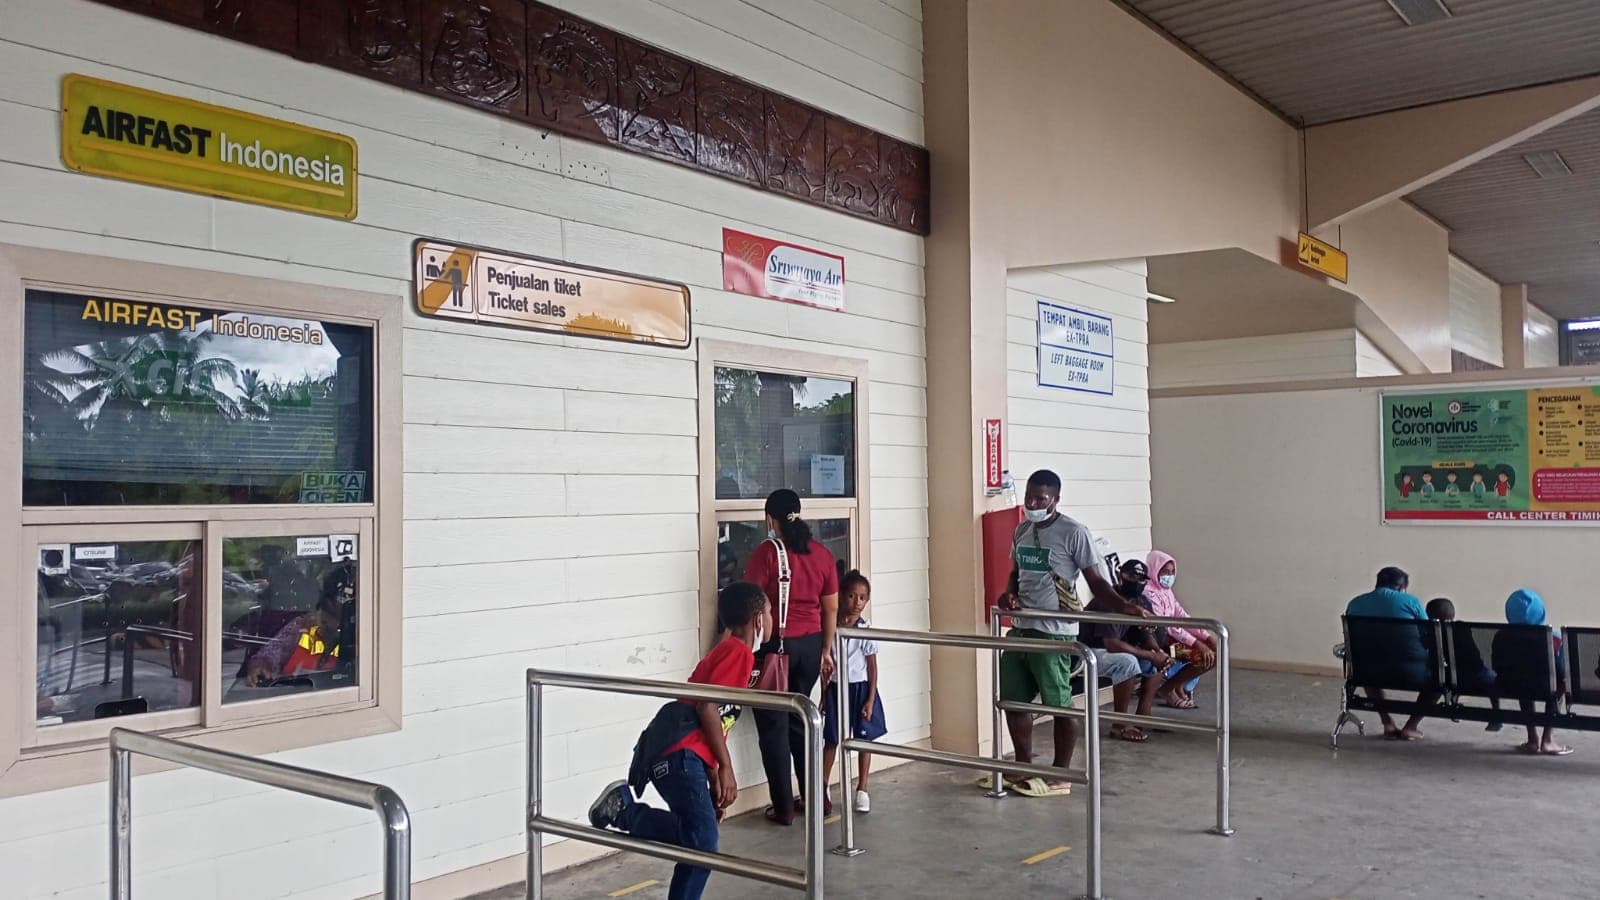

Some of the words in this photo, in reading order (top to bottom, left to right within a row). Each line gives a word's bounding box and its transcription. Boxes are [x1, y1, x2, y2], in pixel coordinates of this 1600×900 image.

[82, 106, 211, 157] AIRFAST
[220, 133, 344, 186] Indonesia
[487, 267, 549, 293] Penjualan
[554, 278, 582, 297] tiket
[824, 268, 841, 285] Air
[488, 291, 528, 312] Ticket
[533, 300, 566, 318] sales
[82, 299, 200, 332] AIRFAST
[212, 313, 323, 345] Indonesia
[1043, 311, 1066, 326] TEMPAT
[1069, 316, 1085, 331] AMBIL
[1088, 321, 1109, 336] BARANG
[1051, 353, 1063, 365] LEFT
[1065, 355, 1088, 369] BAGGAGE
[1090, 359, 1104, 371] ROOM
[1392, 401, 1433, 419] Novel
[1392, 416, 1478, 435] Coronavirus
[1392, 436, 1432, 448] (Covid-19)
[306, 474, 360, 488] BUKA
[1487, 512, 1516, 520] CALL
[1520, 511, 1567, 520] CENTER
